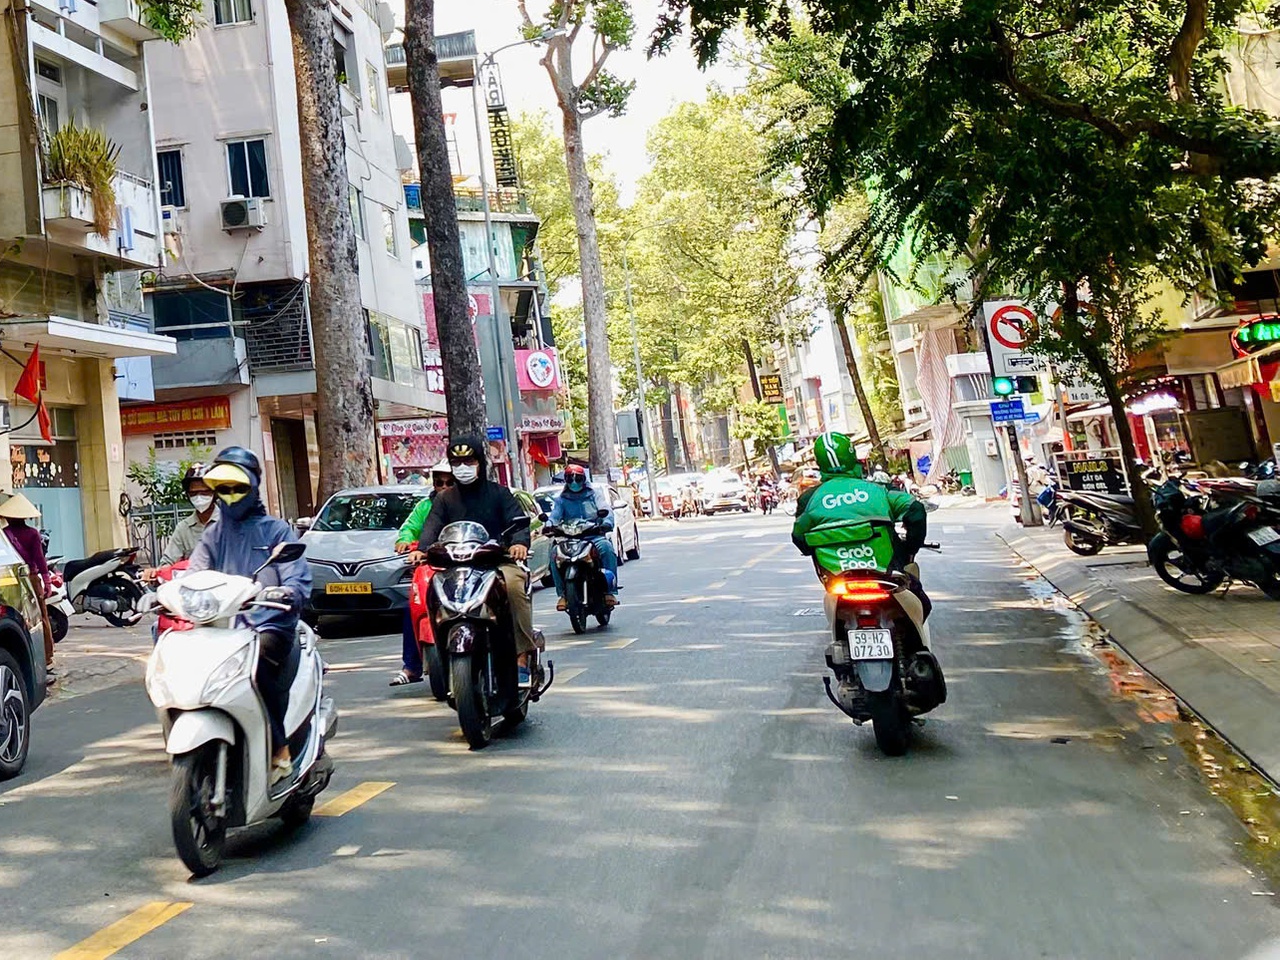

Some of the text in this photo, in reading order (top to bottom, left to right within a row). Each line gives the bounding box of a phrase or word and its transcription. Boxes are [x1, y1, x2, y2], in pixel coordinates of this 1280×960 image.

[1072, 460, 1109, 474] NAILS
[822, 488, 869, 510] Grab
[836, 543, 874, 559] Grab
[839, 555, 878, 571] Food
[853, 644, 890, 658] 072.30
